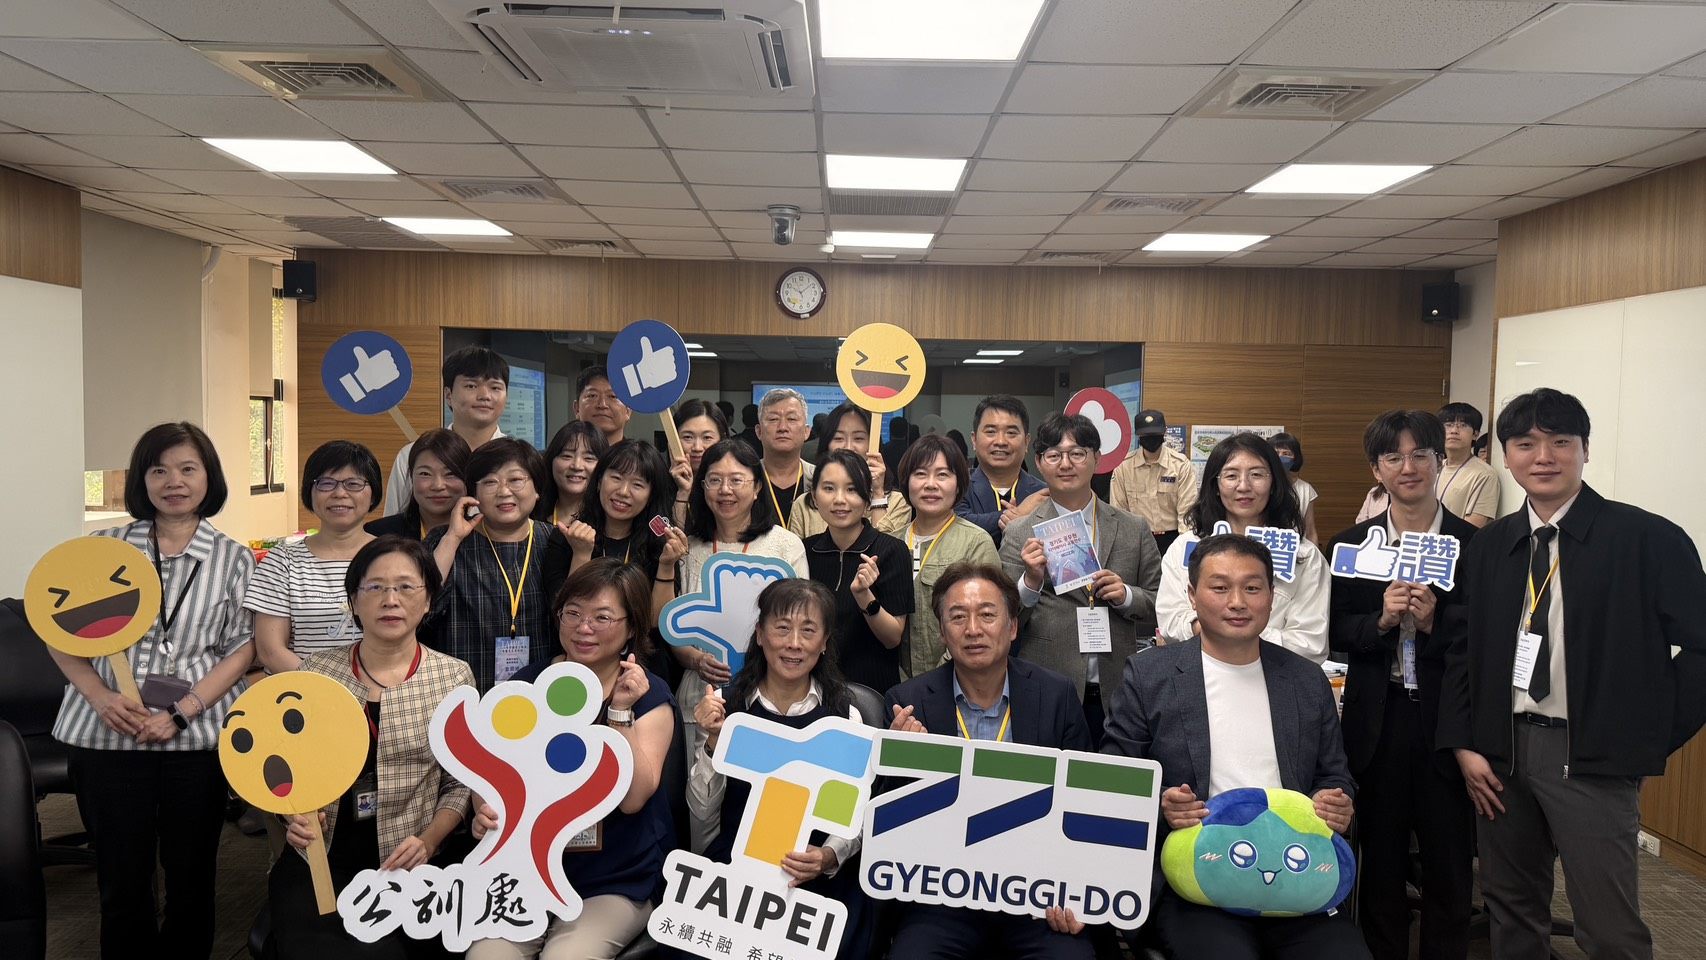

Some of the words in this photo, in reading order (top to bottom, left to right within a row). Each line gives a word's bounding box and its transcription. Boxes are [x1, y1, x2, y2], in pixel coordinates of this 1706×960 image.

[1397, 534, 1457, 588] 讚
[352, 872, 534, 938] 公訓處
[674, 863, 836, 952] TAIPEI
[867, 861, 1142, 921] GYEONGGI-DO
[659, 917, 733, 955] 永續共融
